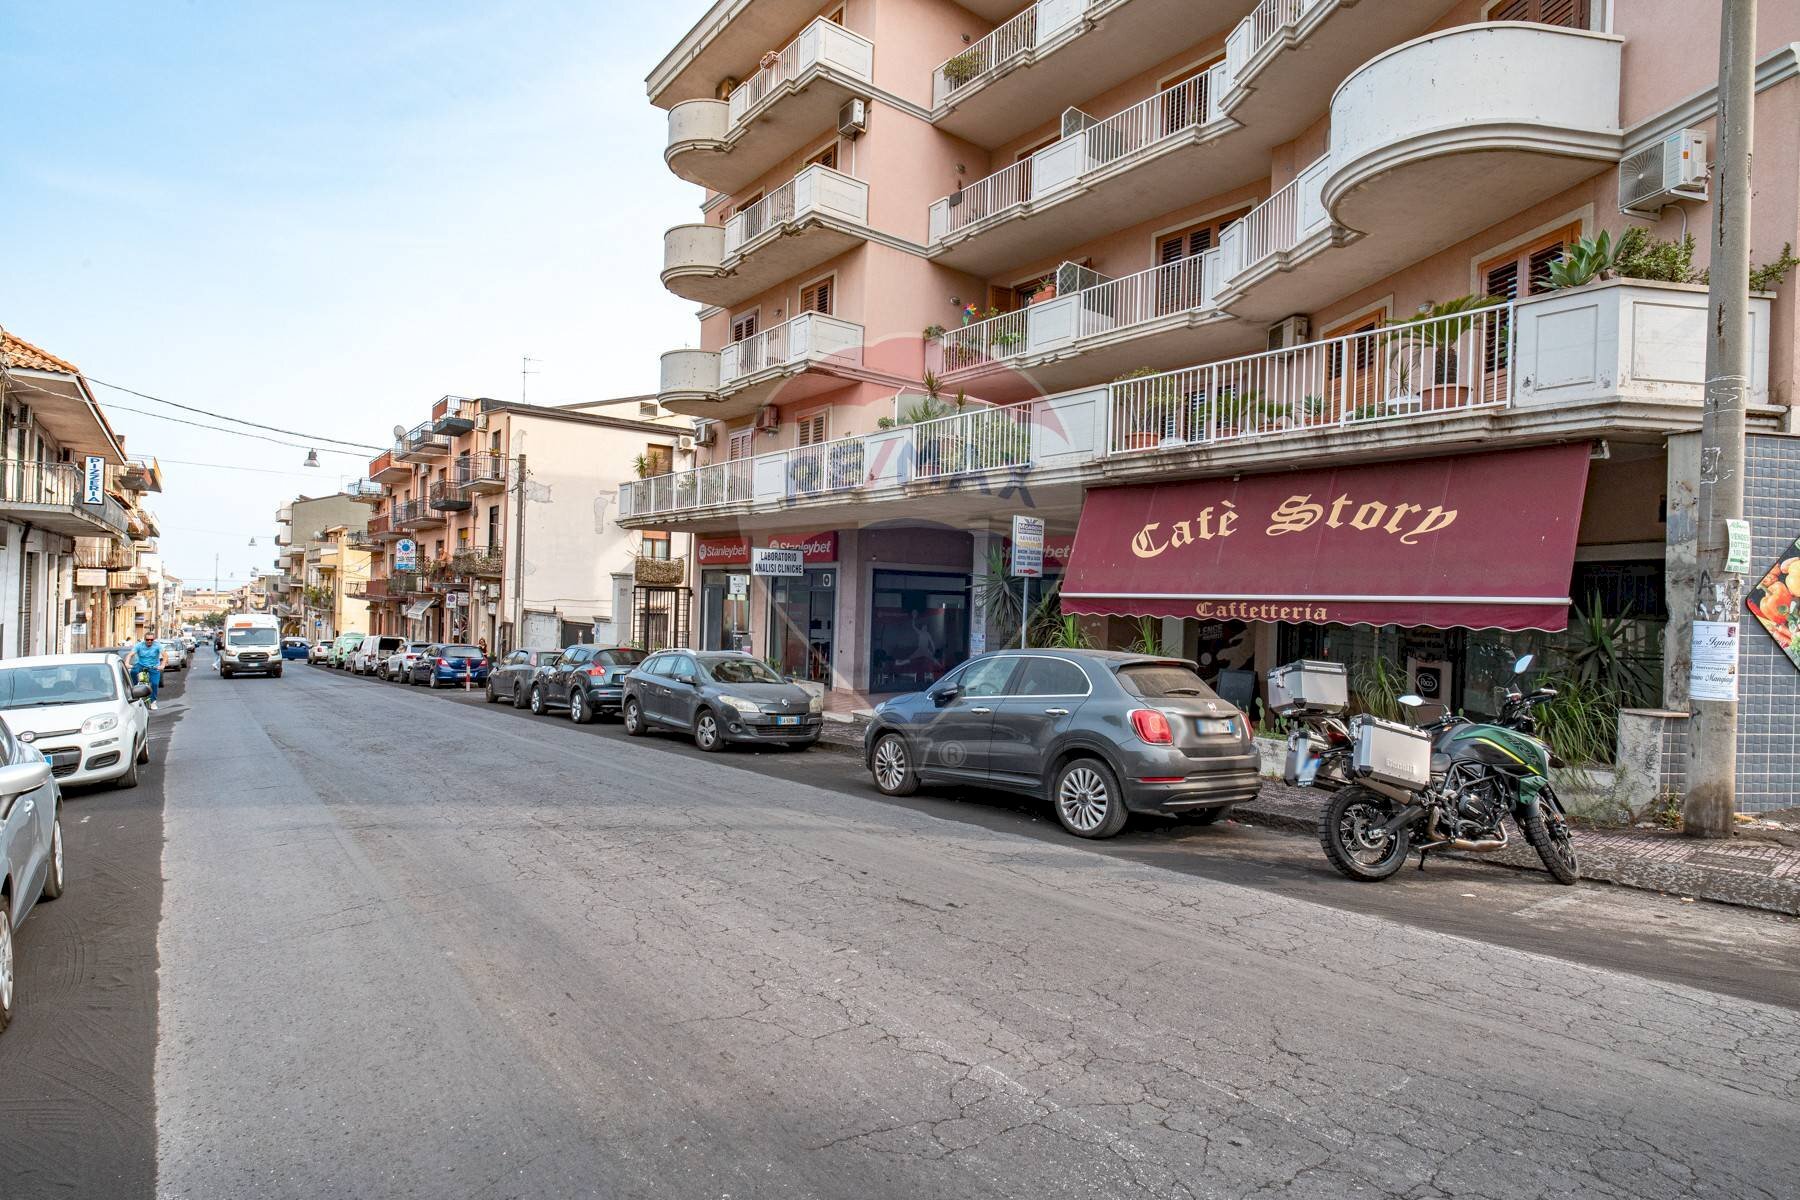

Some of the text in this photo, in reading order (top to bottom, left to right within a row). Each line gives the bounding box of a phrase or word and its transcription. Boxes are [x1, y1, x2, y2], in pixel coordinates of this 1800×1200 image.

[88, 457, 101, 503] PIZZERIA
[1131, 492, 1458, 558] Cafè Story
[706, 544, 746, 558] Stanleybet
[760, 551, 797, 562] LABORATORIO
[755, 563, 802, 574] ANALISI CLINICHE
[1196, 601, 1327, 620] Caffetteria
